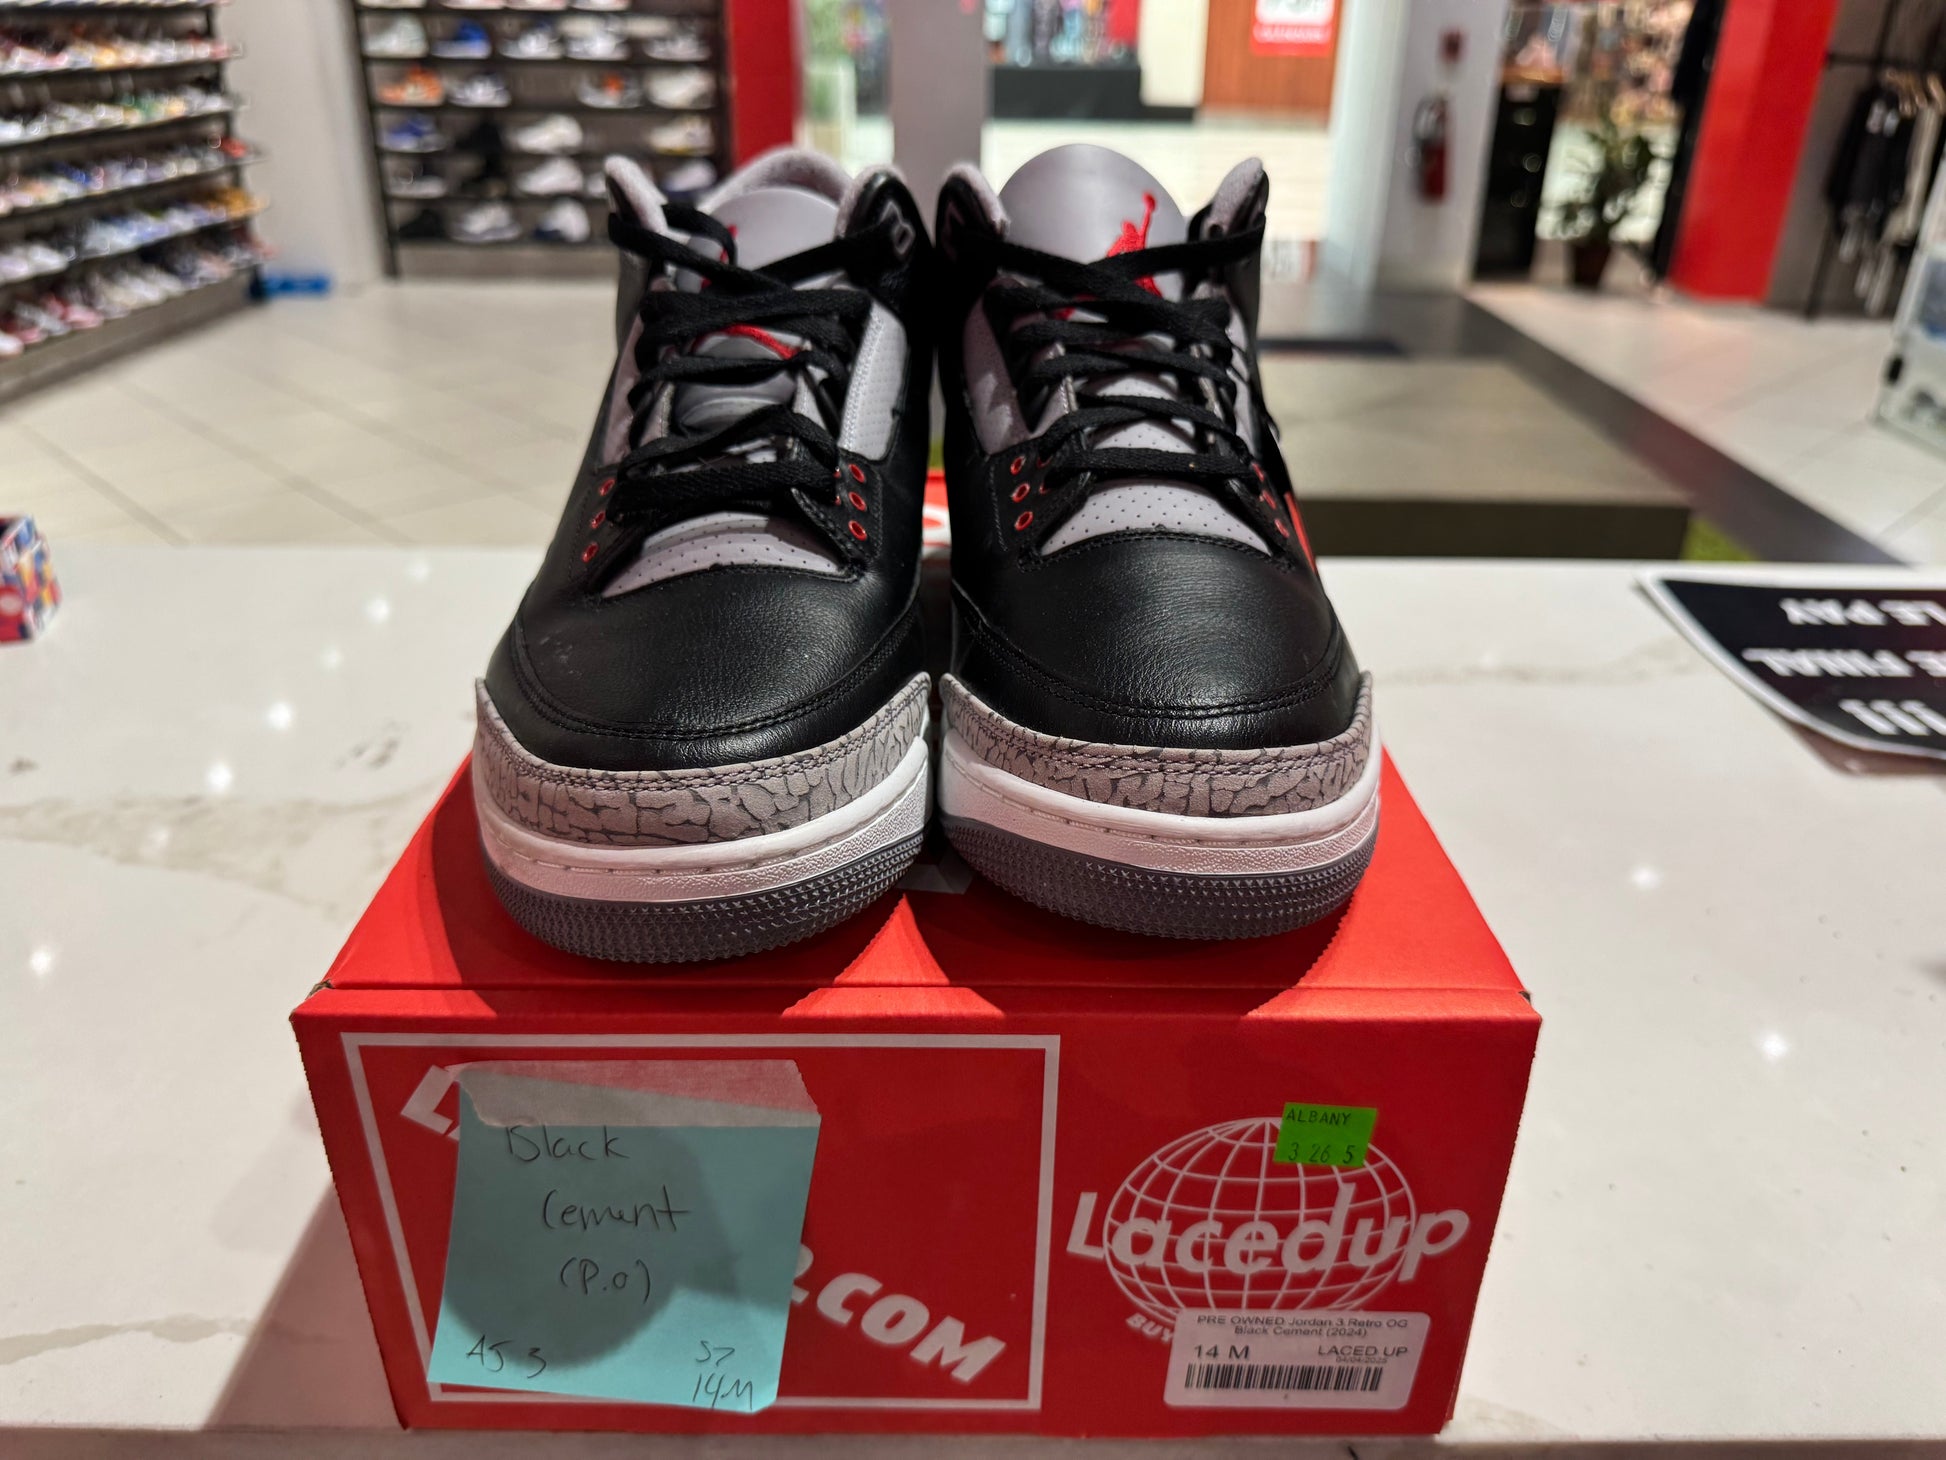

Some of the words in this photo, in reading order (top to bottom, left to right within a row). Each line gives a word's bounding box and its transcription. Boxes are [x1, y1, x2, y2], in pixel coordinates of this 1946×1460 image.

[1286, 1108, 1352, 1126] ALBANY
[1288, 1142, 1299, 1161] 3
[1308, 1143, 1331, 1164] 26
[1342, 1145, 1356, 1165] 5
[1197, 1314, 1227, 1325] PRE
[1230, 1315, 1285, 1326] OWNED
[1288, 1317, 1333, 1327] Jordan
[1347, 1319, 1383, 1329] Retro
[1386, 1320, 1409, 1329] OG
[1234, 1325, 1268, 1336] Black
[1273, 1326, 1323, 1337] Cement
[1326, 1328, 1369, 1338] (2024)
[1194, 1344, 1219, 1359] 14
[1228, 1344, 1250, 1360] M
[1317, 1345, 1378, 1357] LACED
[1382, 1346, 1409, 1358] UP
